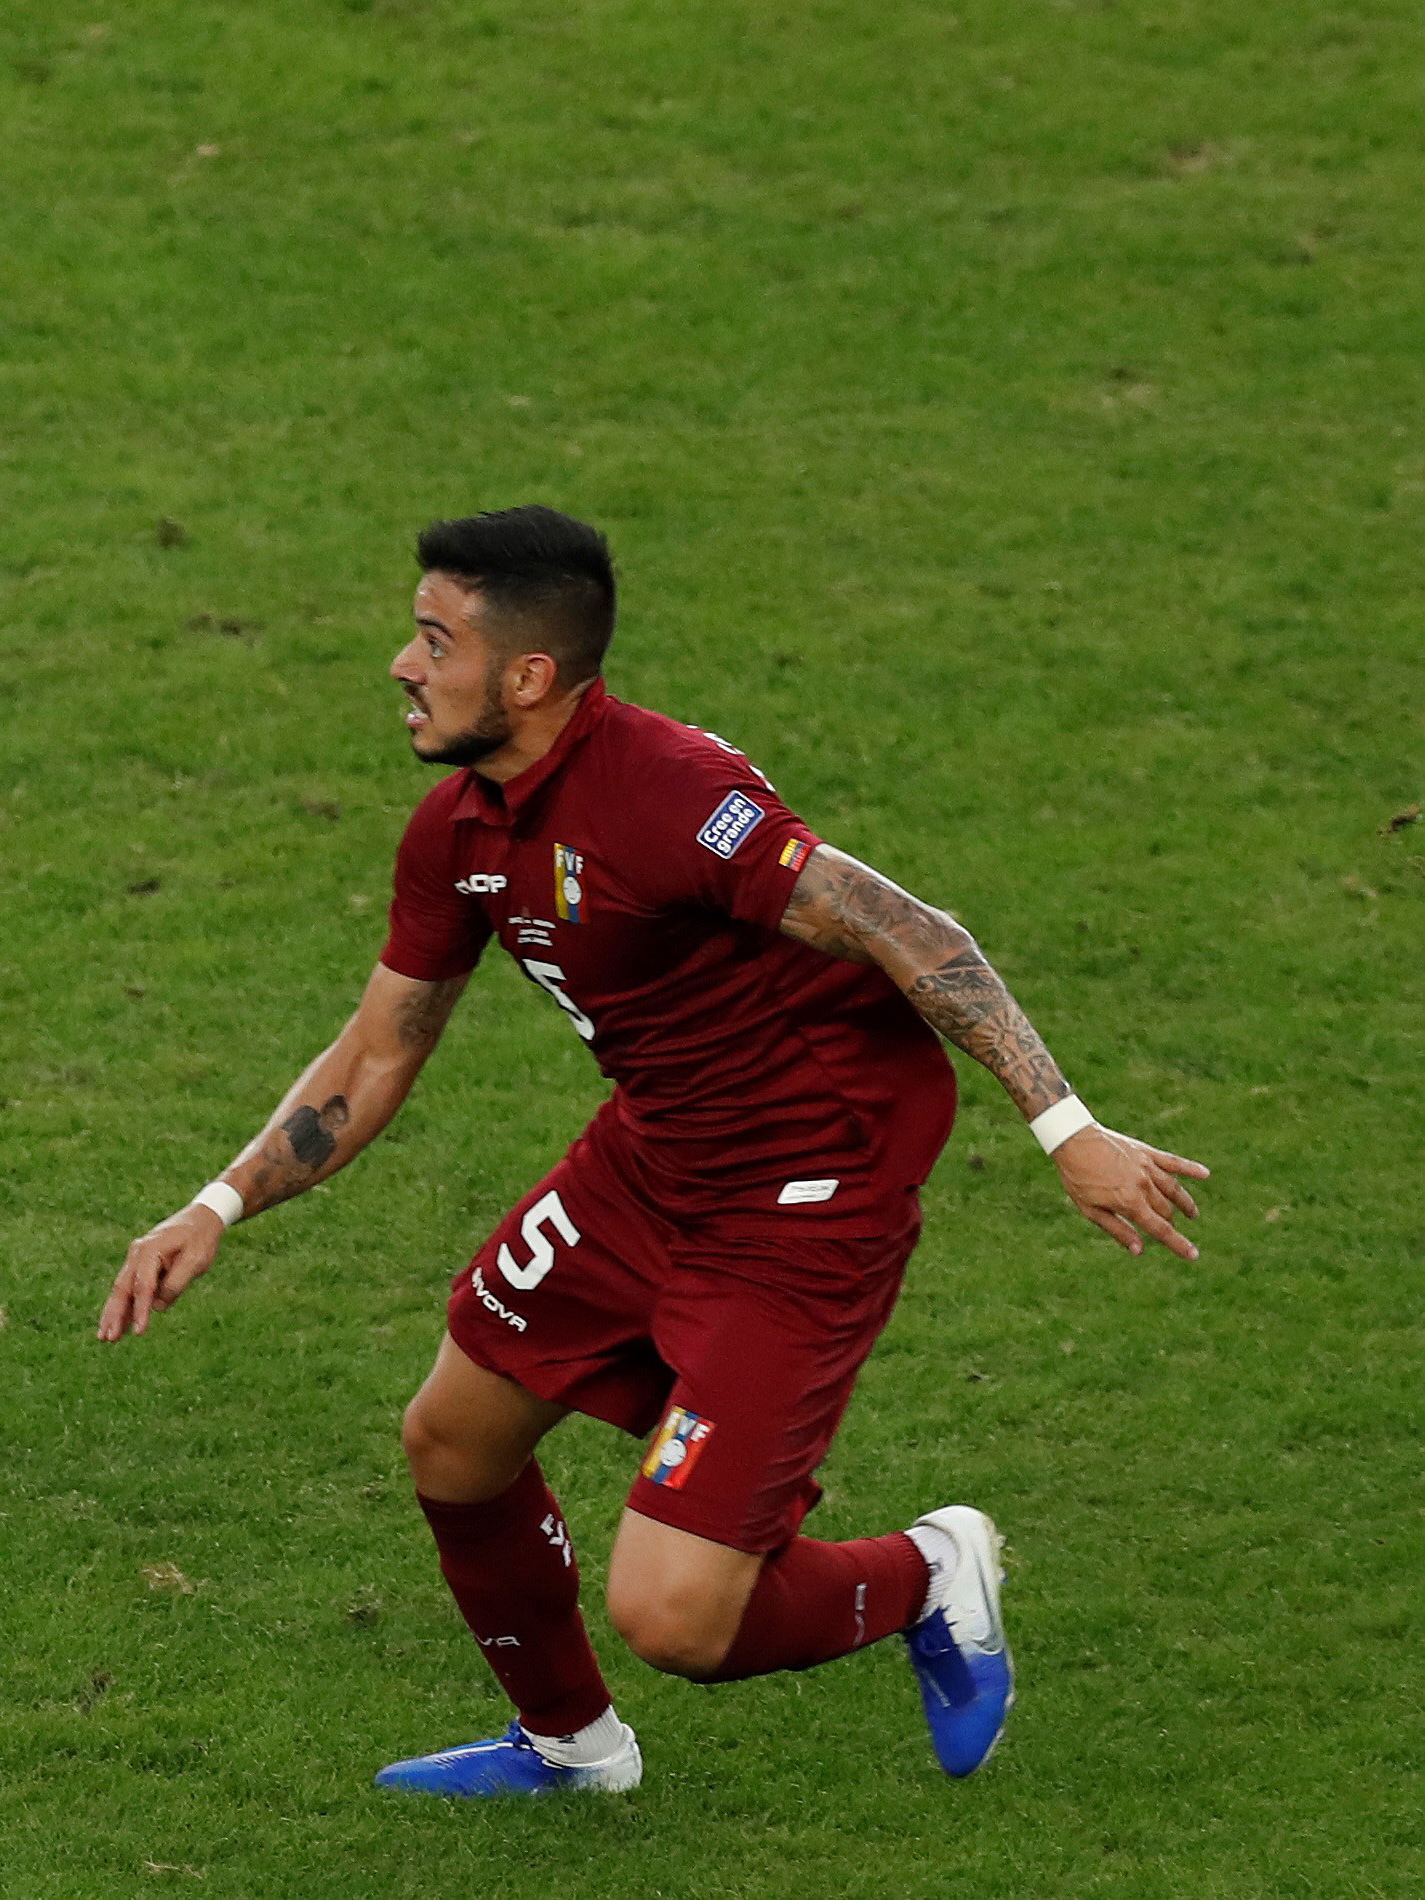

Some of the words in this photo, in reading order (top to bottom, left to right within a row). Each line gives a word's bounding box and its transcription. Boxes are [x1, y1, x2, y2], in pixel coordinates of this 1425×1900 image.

[703, 812, 733, 843] Cree
[728, 798, 747, 815] en
[716, 807, 755, 854] grande
[556, 849, 584, 875] FVF
[497, 1189, 582, 1290] 5
[664, 1410, 711, 1443] FVF
